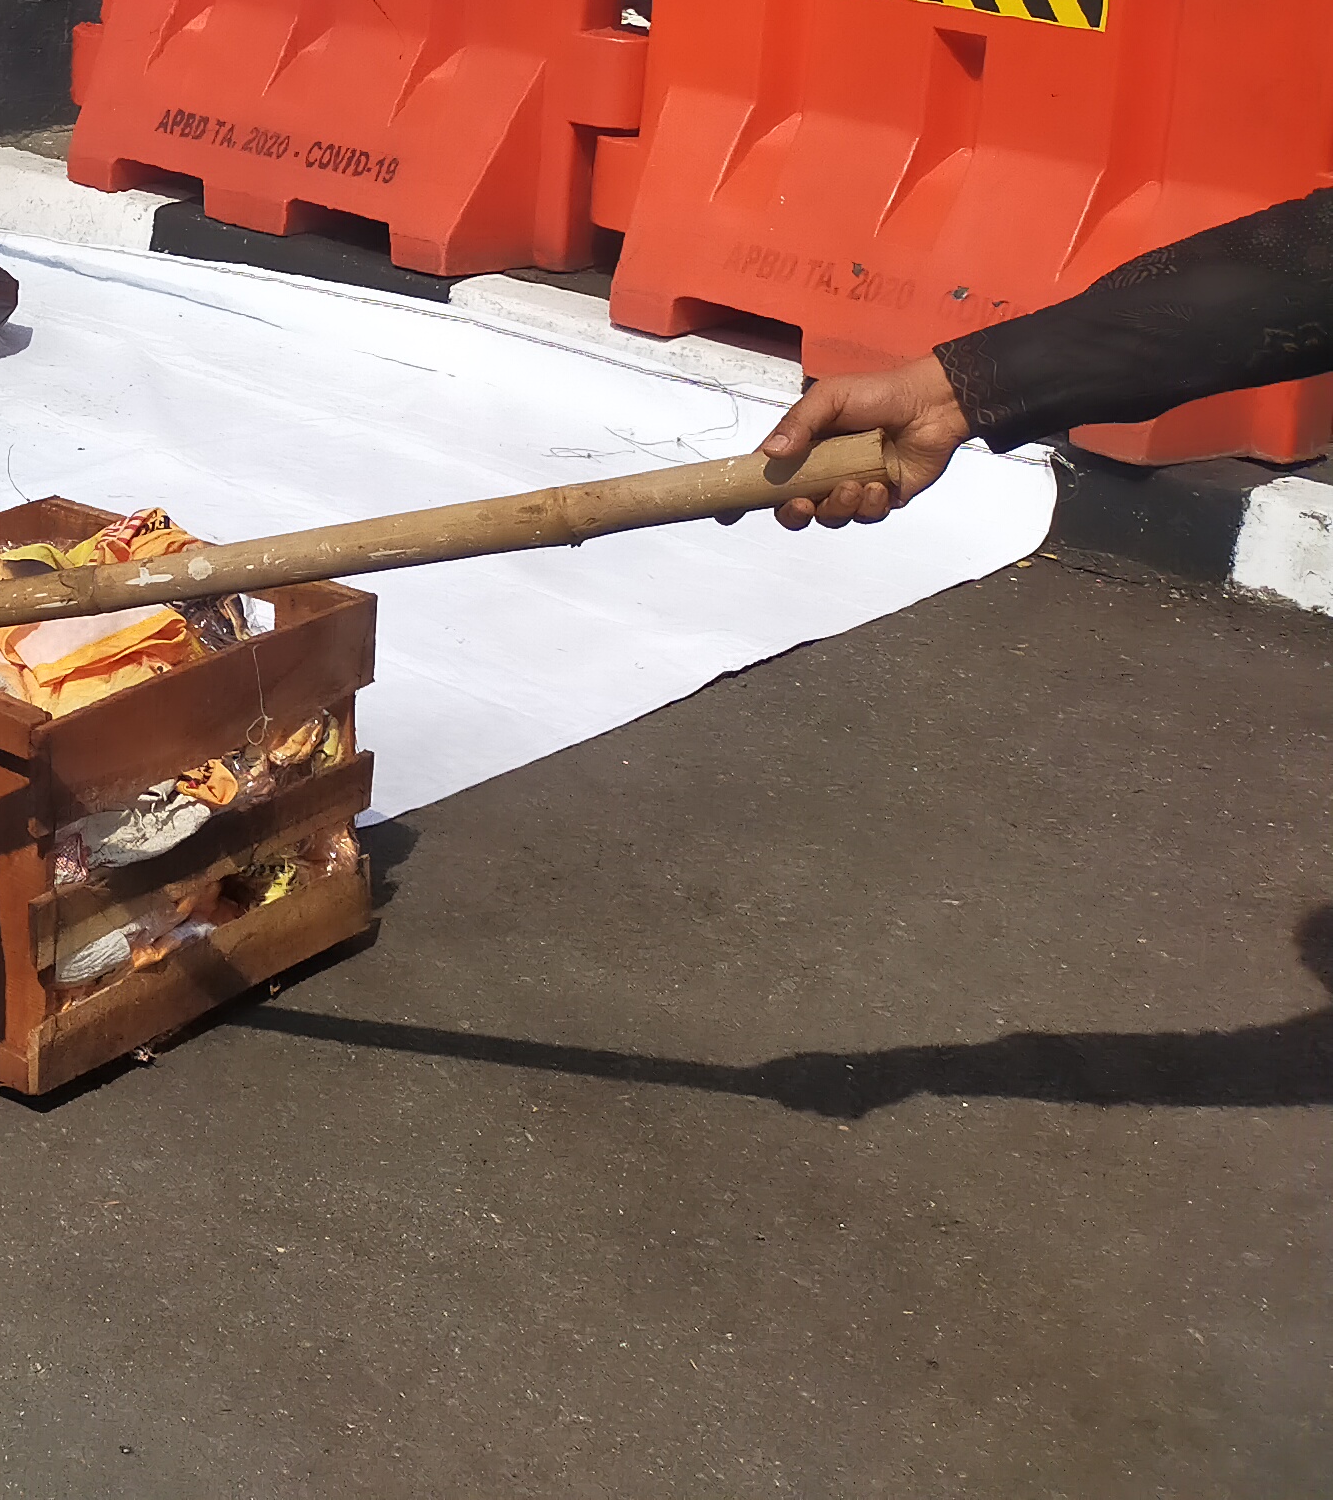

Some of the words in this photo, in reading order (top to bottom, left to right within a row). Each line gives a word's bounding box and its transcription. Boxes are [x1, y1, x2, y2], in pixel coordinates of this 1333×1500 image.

[154, 108, 209, 140] APBD
[211, 118, 237, 148] TA.
[241, 126, 291, 160] 2020
[305, 141, 400, 183] COVID-19
